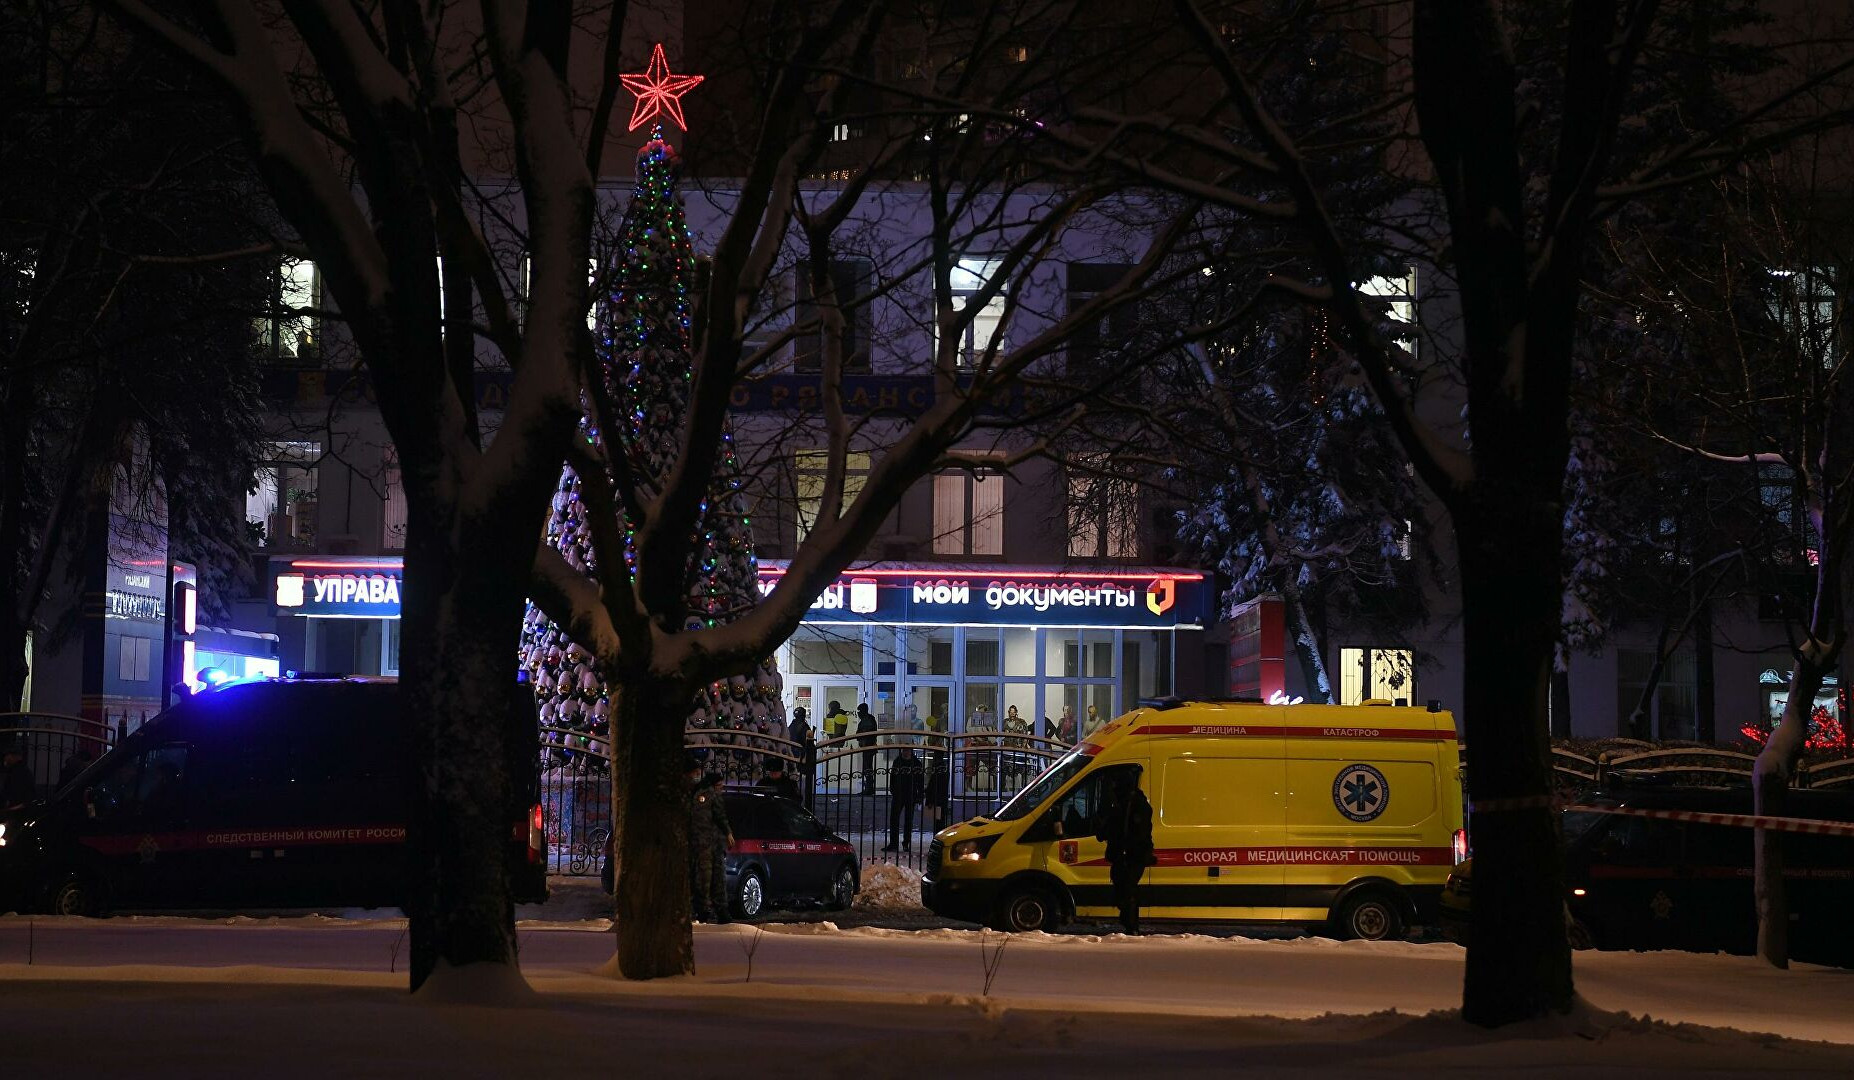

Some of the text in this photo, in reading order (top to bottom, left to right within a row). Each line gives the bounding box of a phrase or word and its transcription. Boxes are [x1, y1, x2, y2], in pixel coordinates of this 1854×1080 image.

[313, 575, 399, 603] УПРАВА
[1192, 725, 1379, 737] МЕДИЦИНА КАТАСТРОФ
[206, 830, 304, 844] СЛЕДСТВЕННЫЙ
[307, 829, 361, 839] КОМИТЕТ
[1184, 850, 1420, 863] СКОРАЯ МЕДИЦИНСКАЯ ПОМОЩЬ
